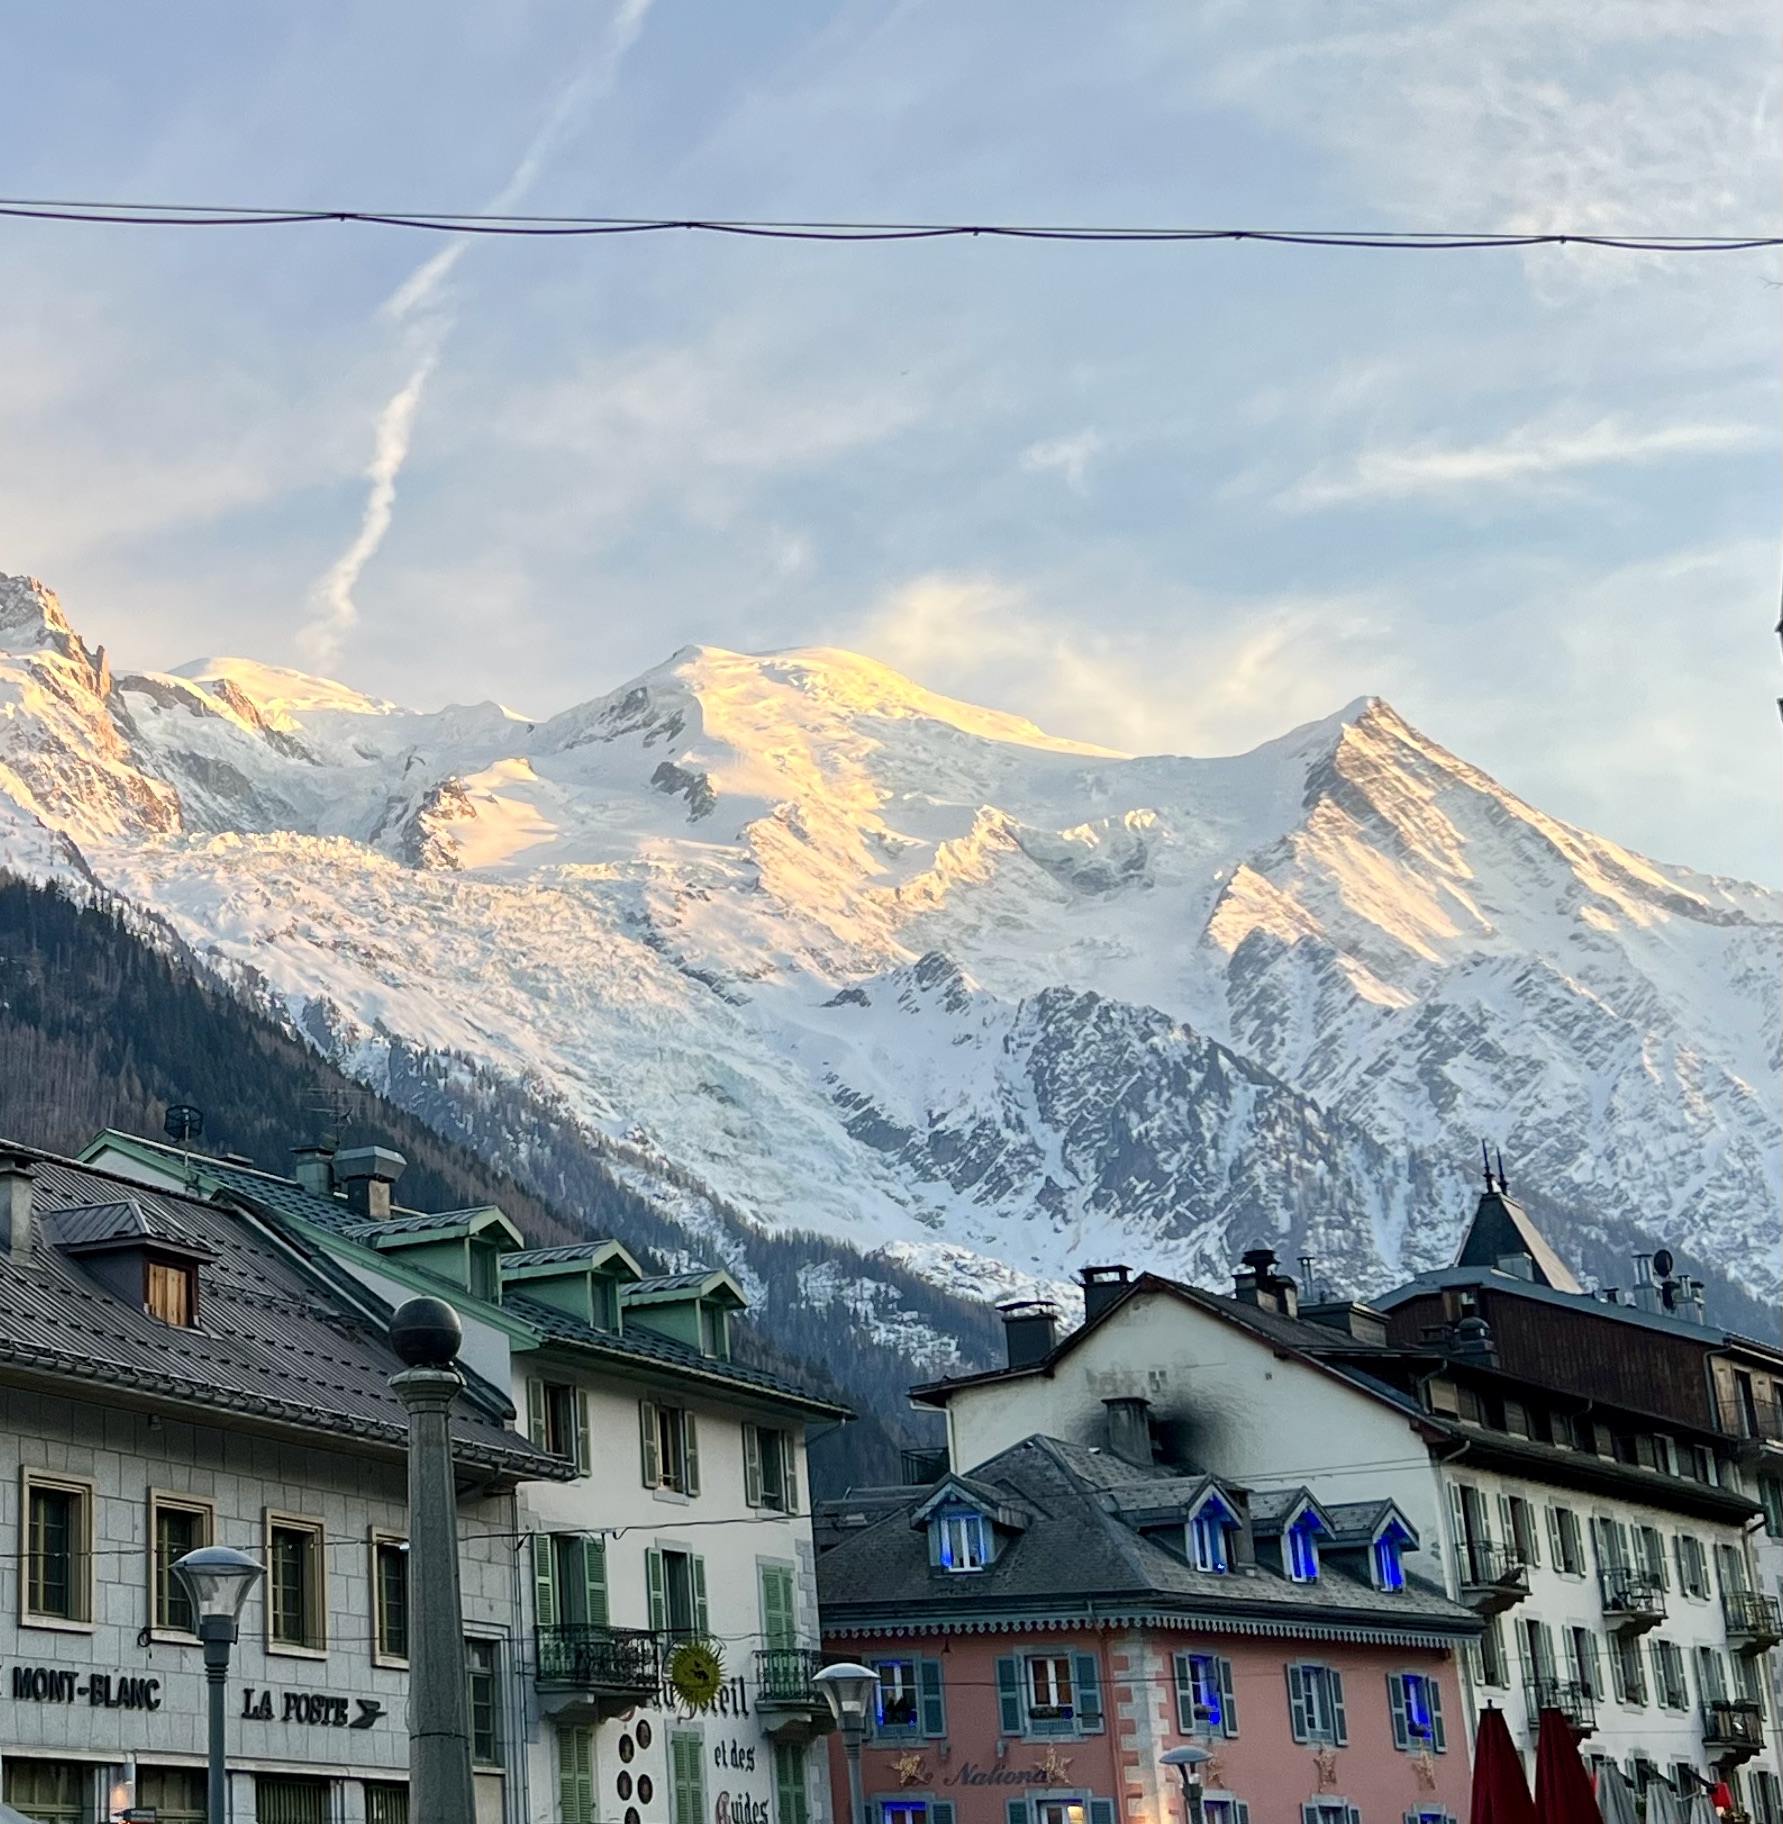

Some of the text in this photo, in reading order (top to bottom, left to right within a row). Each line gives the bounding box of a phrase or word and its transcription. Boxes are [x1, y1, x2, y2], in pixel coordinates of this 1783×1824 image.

[13, 1666, 162, 1711] MONT-BLANC
[241, 1688, 349, 1726] LA POSTE
[677, 1674, 750, 1725] eil
[730, 1738, 756, 1773] des
